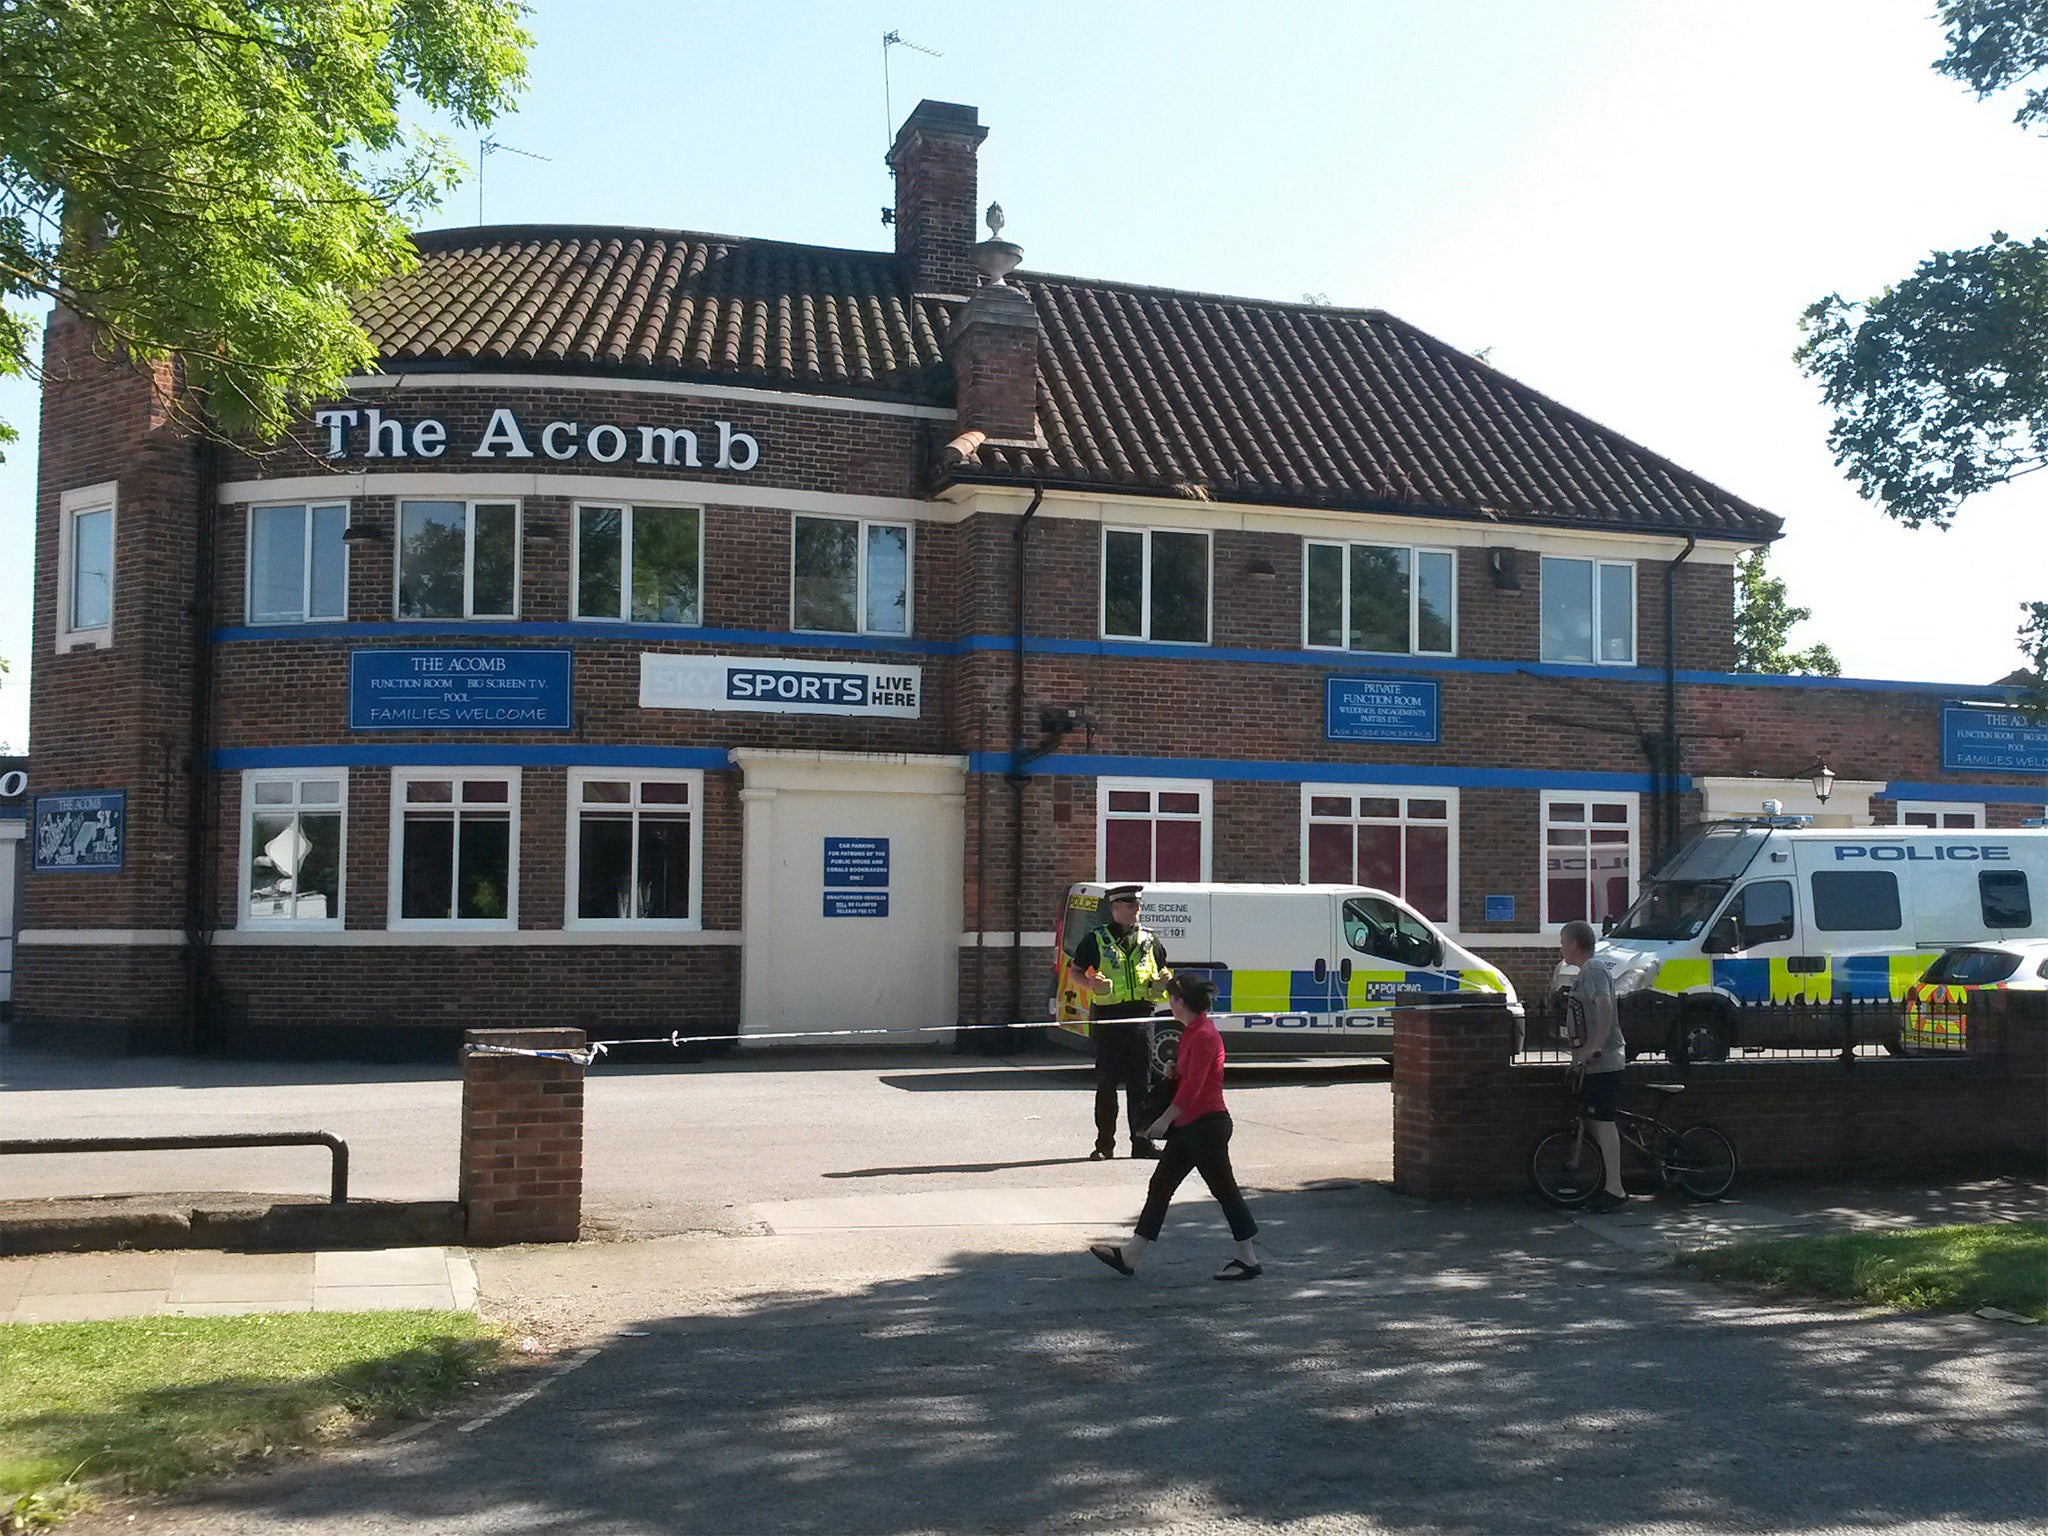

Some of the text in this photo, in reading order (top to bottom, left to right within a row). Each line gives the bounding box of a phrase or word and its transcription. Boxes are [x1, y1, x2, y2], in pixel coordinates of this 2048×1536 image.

[315, 408, 760, 472] The Acomb
[411, 657, 506, 671] THE ACOMB
[371, 679, 421, 689] FUNCTION
[423, 679, 453, 689] ROOM
[467, 679, 484, 689] BIG
[486, 679, 526, 689] SCREEN
[732, 673, 863, 701] SPORTS
[876, 676, 912, 691] LIVE
[1364, 683, 1401, 694] PRIVATE
[444, 693, 470, 702] POOL
[872, 692, 916, 707] HERE
[1343, 694, 1422, 706] FUNCTION ROOM
[371, 707, 548, 721] FAMILIES WELCOME
[1360, 715, 1387, 723] PARTIES
[1985, 713, 2008, 726] THE
[1957, 729, 1993, 740] FUNCTION
[1993, 731, 2014, 740] ROOM
[2007, 743, 2026, 752] POOL
[1957, 754, 2013, 766] FAMILIES
[58, 800, 73, 811] THE
[1834, 846, 2011, 861] POLICE
[1158, 903, 1189, 912] SCENE
[1139, 914, 1192, 923] ESTIGATION
[1171, 929, 1185, 937] 101
[1244, 1015, 1395, 1029] POLICE
